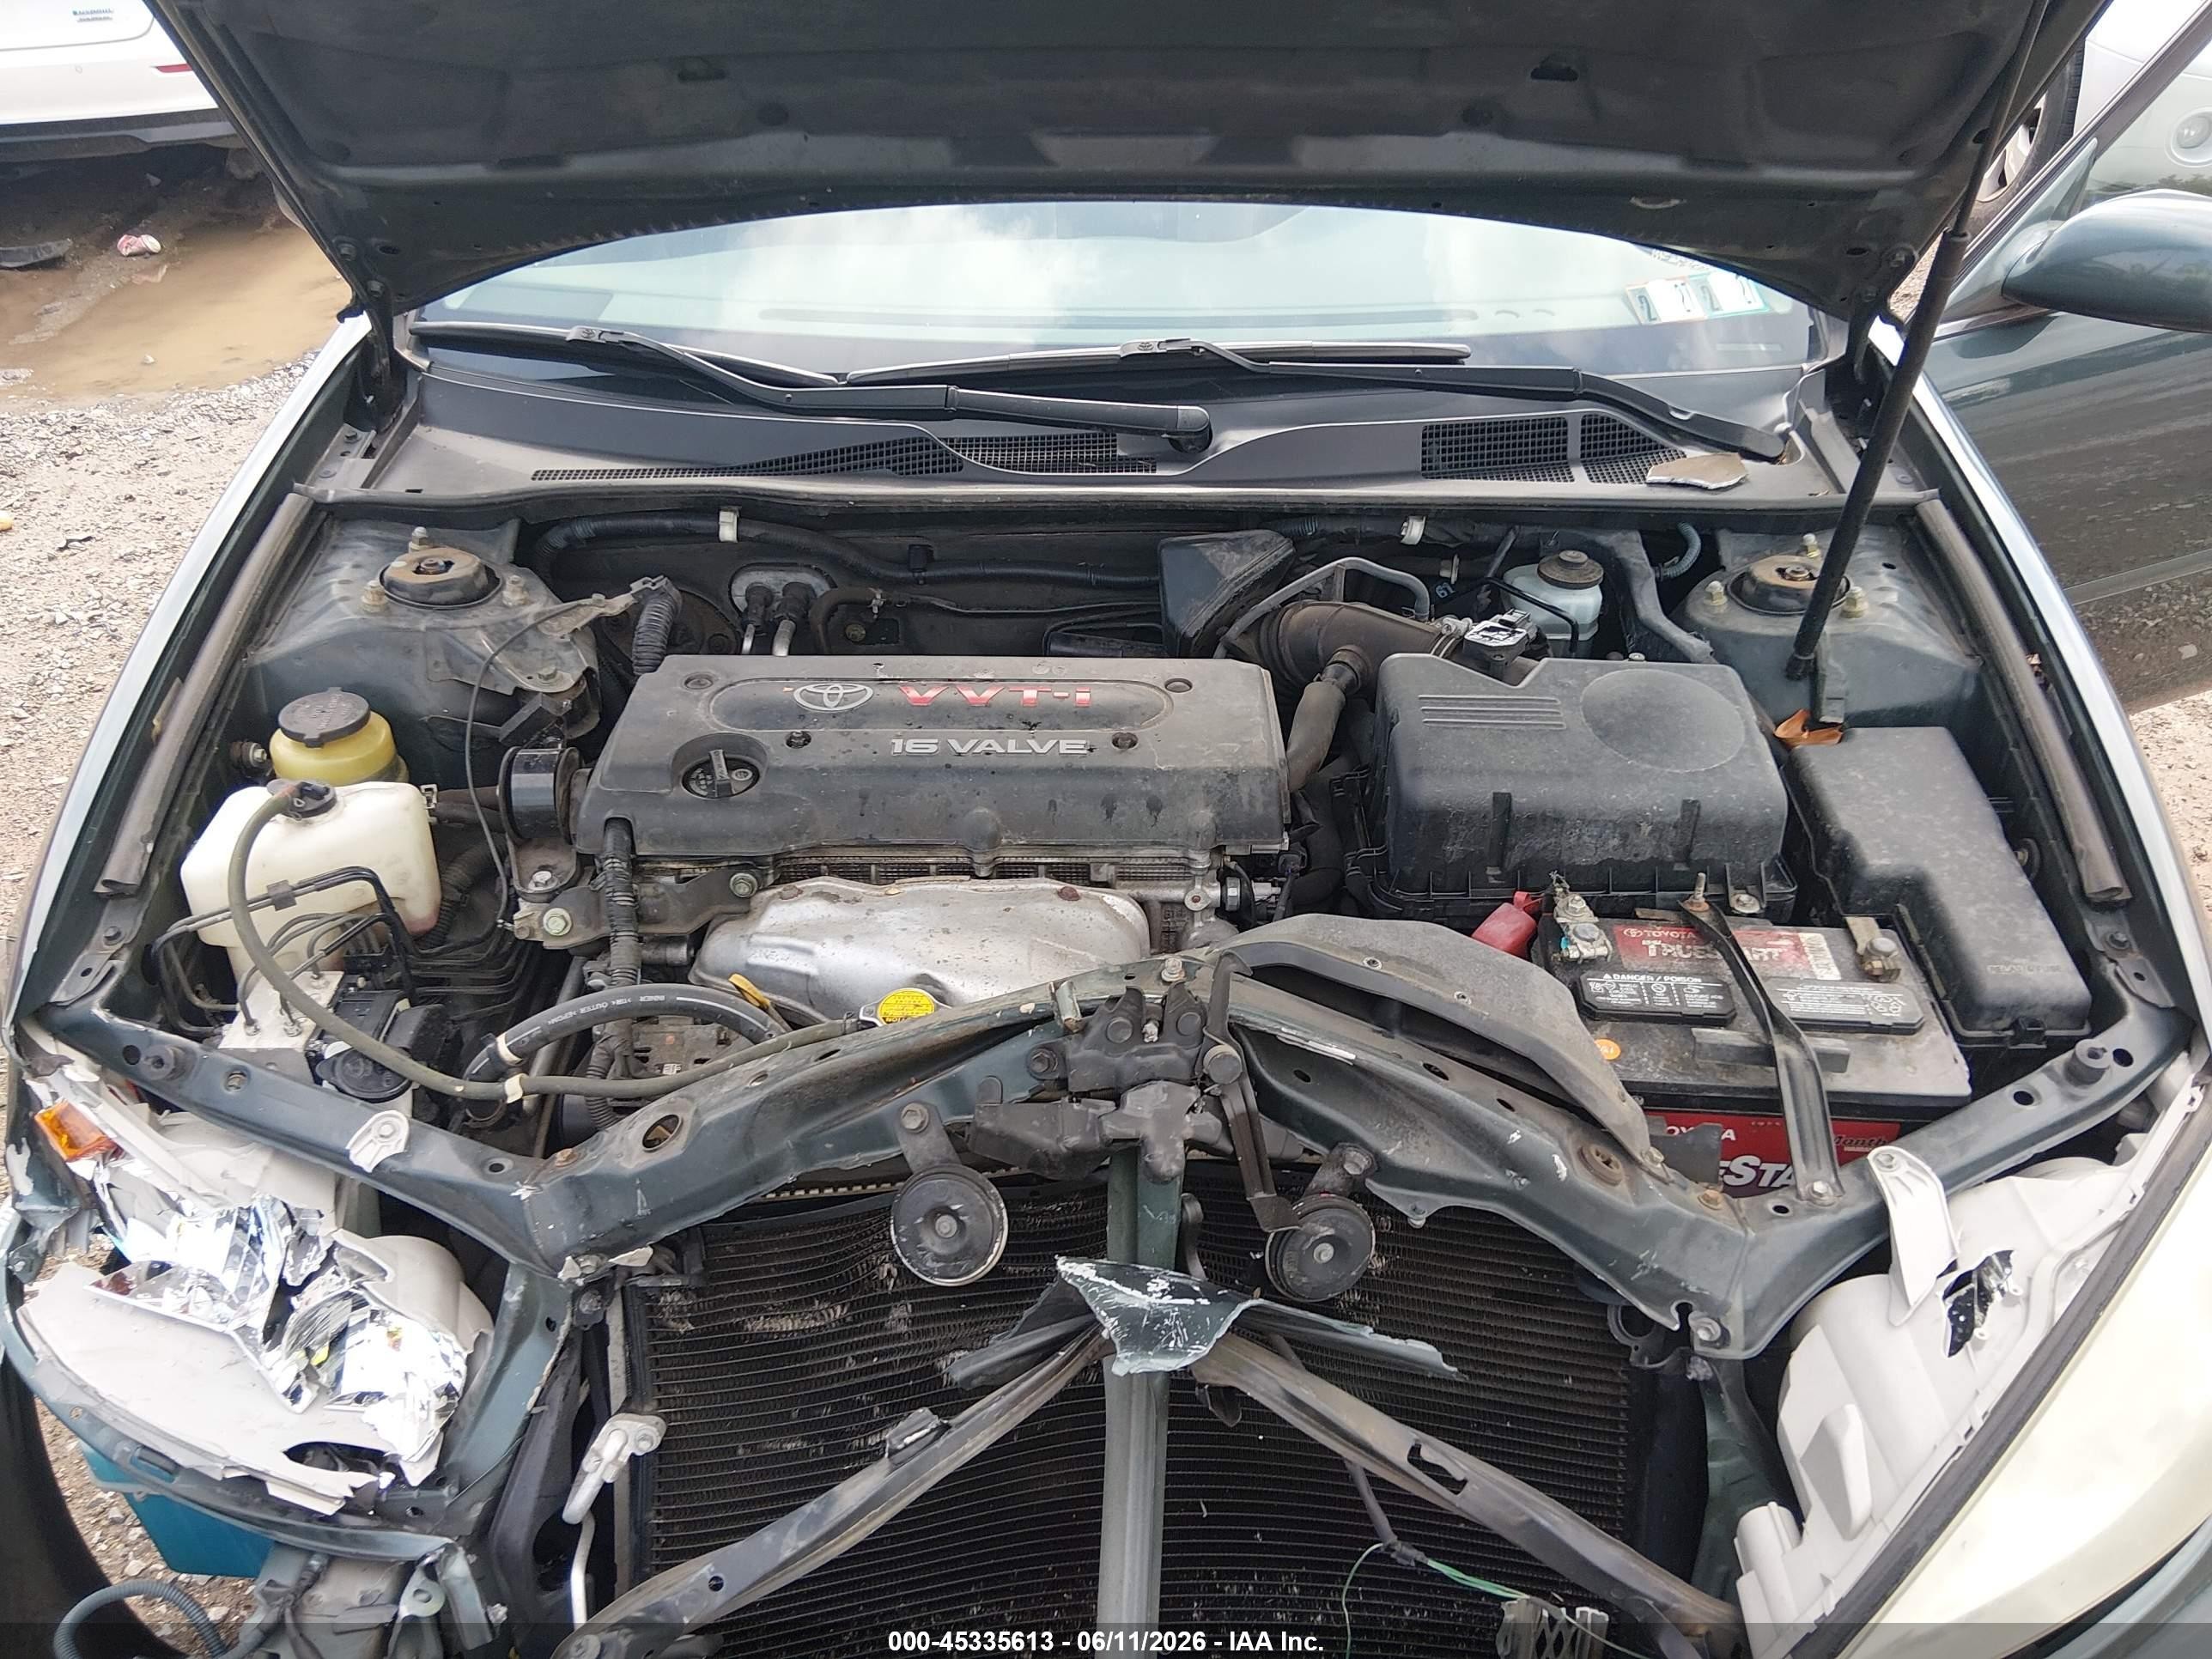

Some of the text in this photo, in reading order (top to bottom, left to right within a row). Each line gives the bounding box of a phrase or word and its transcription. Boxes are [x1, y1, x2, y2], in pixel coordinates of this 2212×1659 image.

[890, 738, 1088, 755] 16 VALVE
[1644, 928, 1698, 939] TOYOTA
[1612, 973, 1655, 982] DANGER
[1662, 975, 1703, 984] POISON
